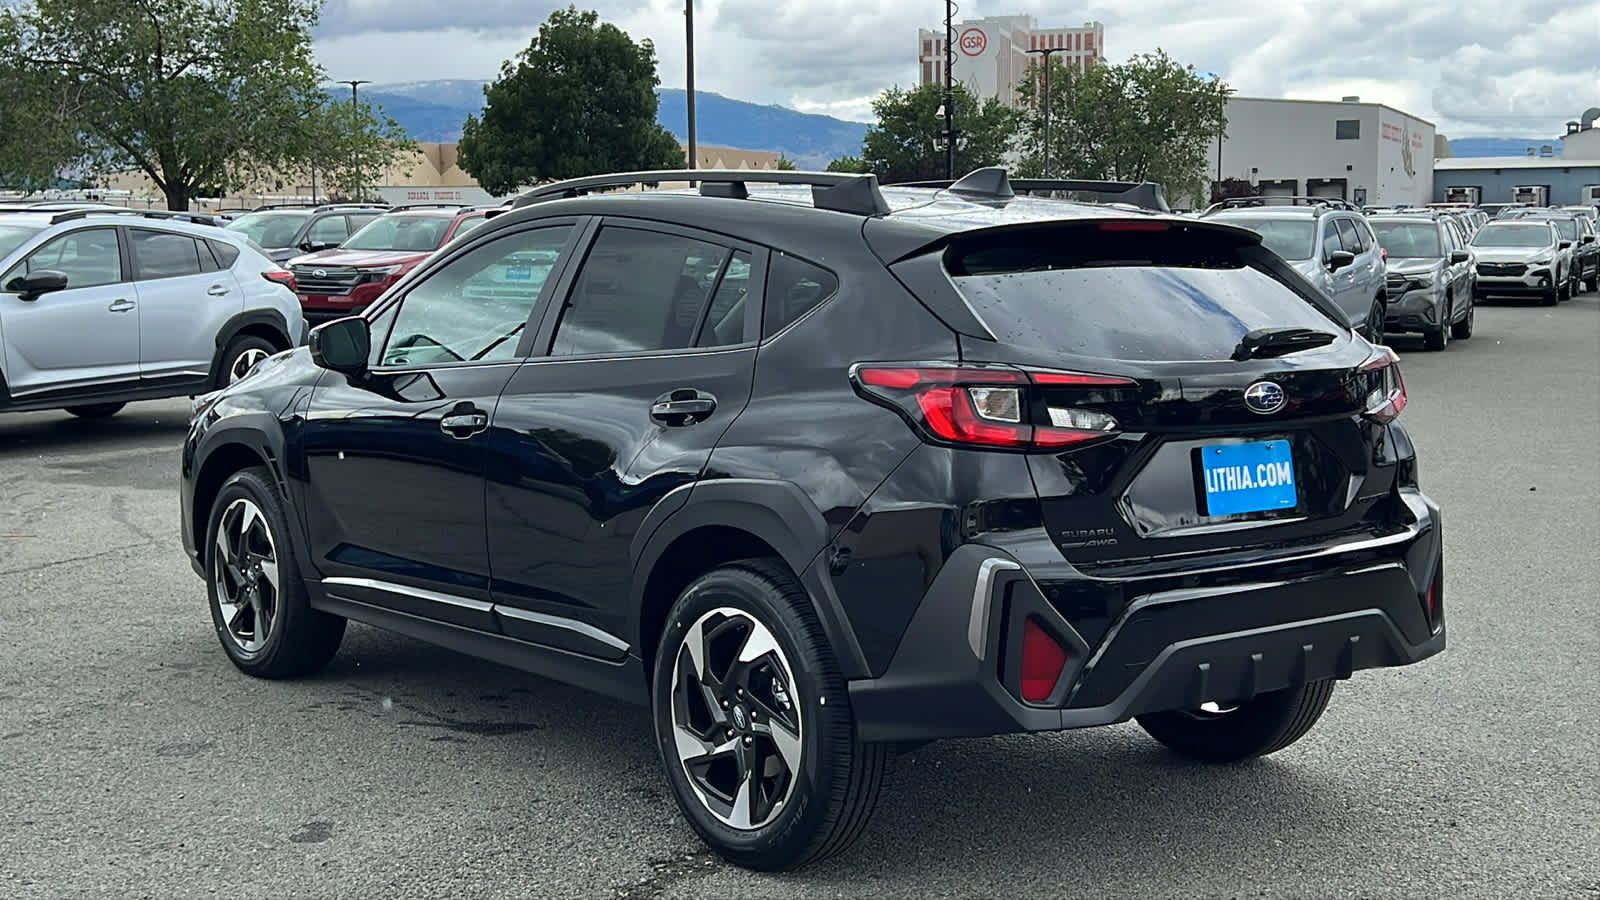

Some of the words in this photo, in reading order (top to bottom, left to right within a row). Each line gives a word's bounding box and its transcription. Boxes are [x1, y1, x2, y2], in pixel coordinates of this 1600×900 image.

[963, 36, 983, 48] GSR
[1206, 461, 1292, 493] LITHIA.COM
[1062, 528, 1114, 538] SUBARU
[1085, 538, 1119, 547] AWD
